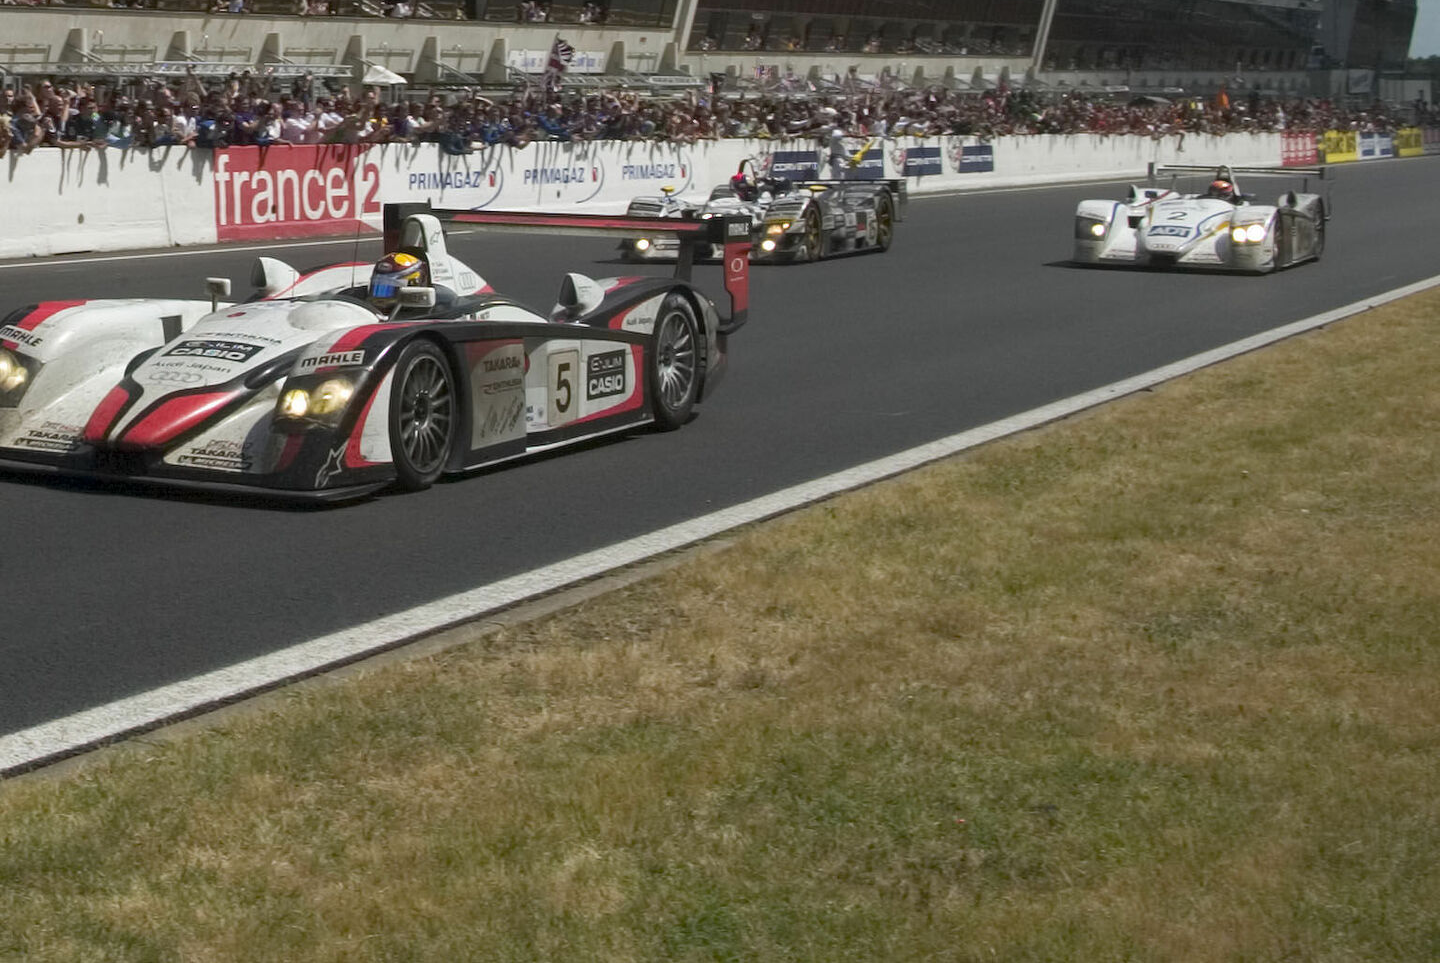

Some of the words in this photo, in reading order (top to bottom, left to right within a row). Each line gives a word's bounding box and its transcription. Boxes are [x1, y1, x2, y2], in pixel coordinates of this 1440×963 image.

[408, 170, 481, 190] PRIMAGAZ
[524, 167, 585, 185] PRIMAGAZ
[622, 163, 675, 180] PRIMAGAZ
[215, 154, 350, 225] france
[363, 162, 381, 213] 2
[1167, 211, 1188, 221] 2
[1149, 226, 1190, 236] ADT
[0, 327, 43, 347] MAHLE
[170, 348, 247, 360] CASIO
[301, 352, 362, 368] MAHLE
[555, 362, 571, 413] 5
[589, 374, 623, 395] CASIO
[191, 448, 248, 460] TAKARA
